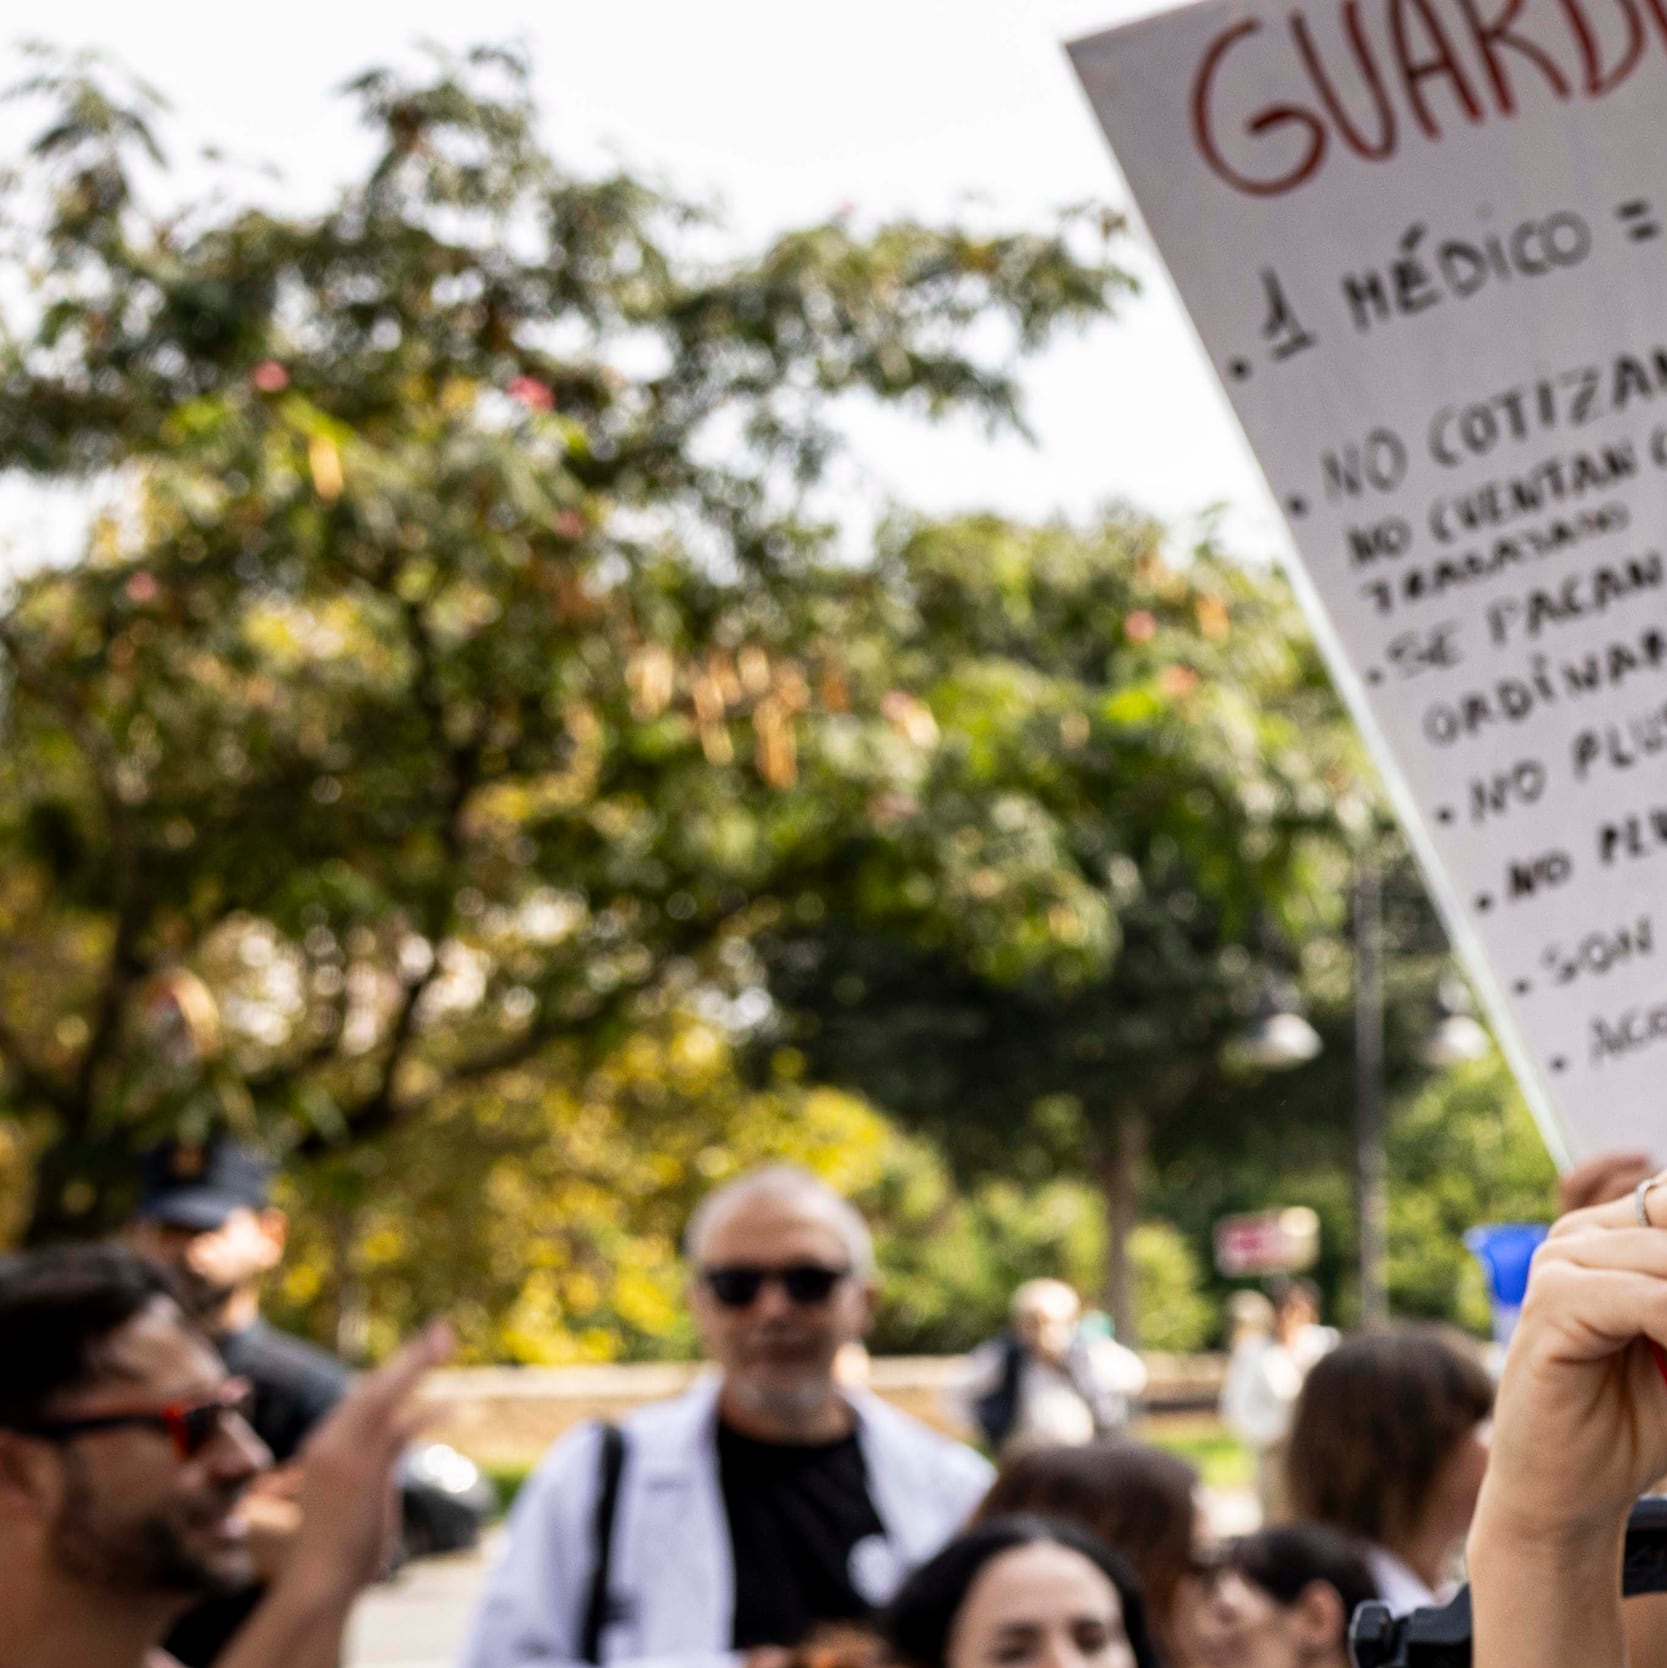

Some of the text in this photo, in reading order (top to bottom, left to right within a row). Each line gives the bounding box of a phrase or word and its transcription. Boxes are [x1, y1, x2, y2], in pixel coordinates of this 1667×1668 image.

[1340, 209, 1593, 331] MÉDICO
[1320, 426, 1410, 501] NO
[1347, 514, 1413, 569] NO
[1427, 438, 1637, 545] CUENTAN
[1387, 619, 1465, 677] SE
[1468, 761, 1549, 822] NO
[1505, 846, 1573, 901] NO
[1540, 912, 1654, 988] SON
